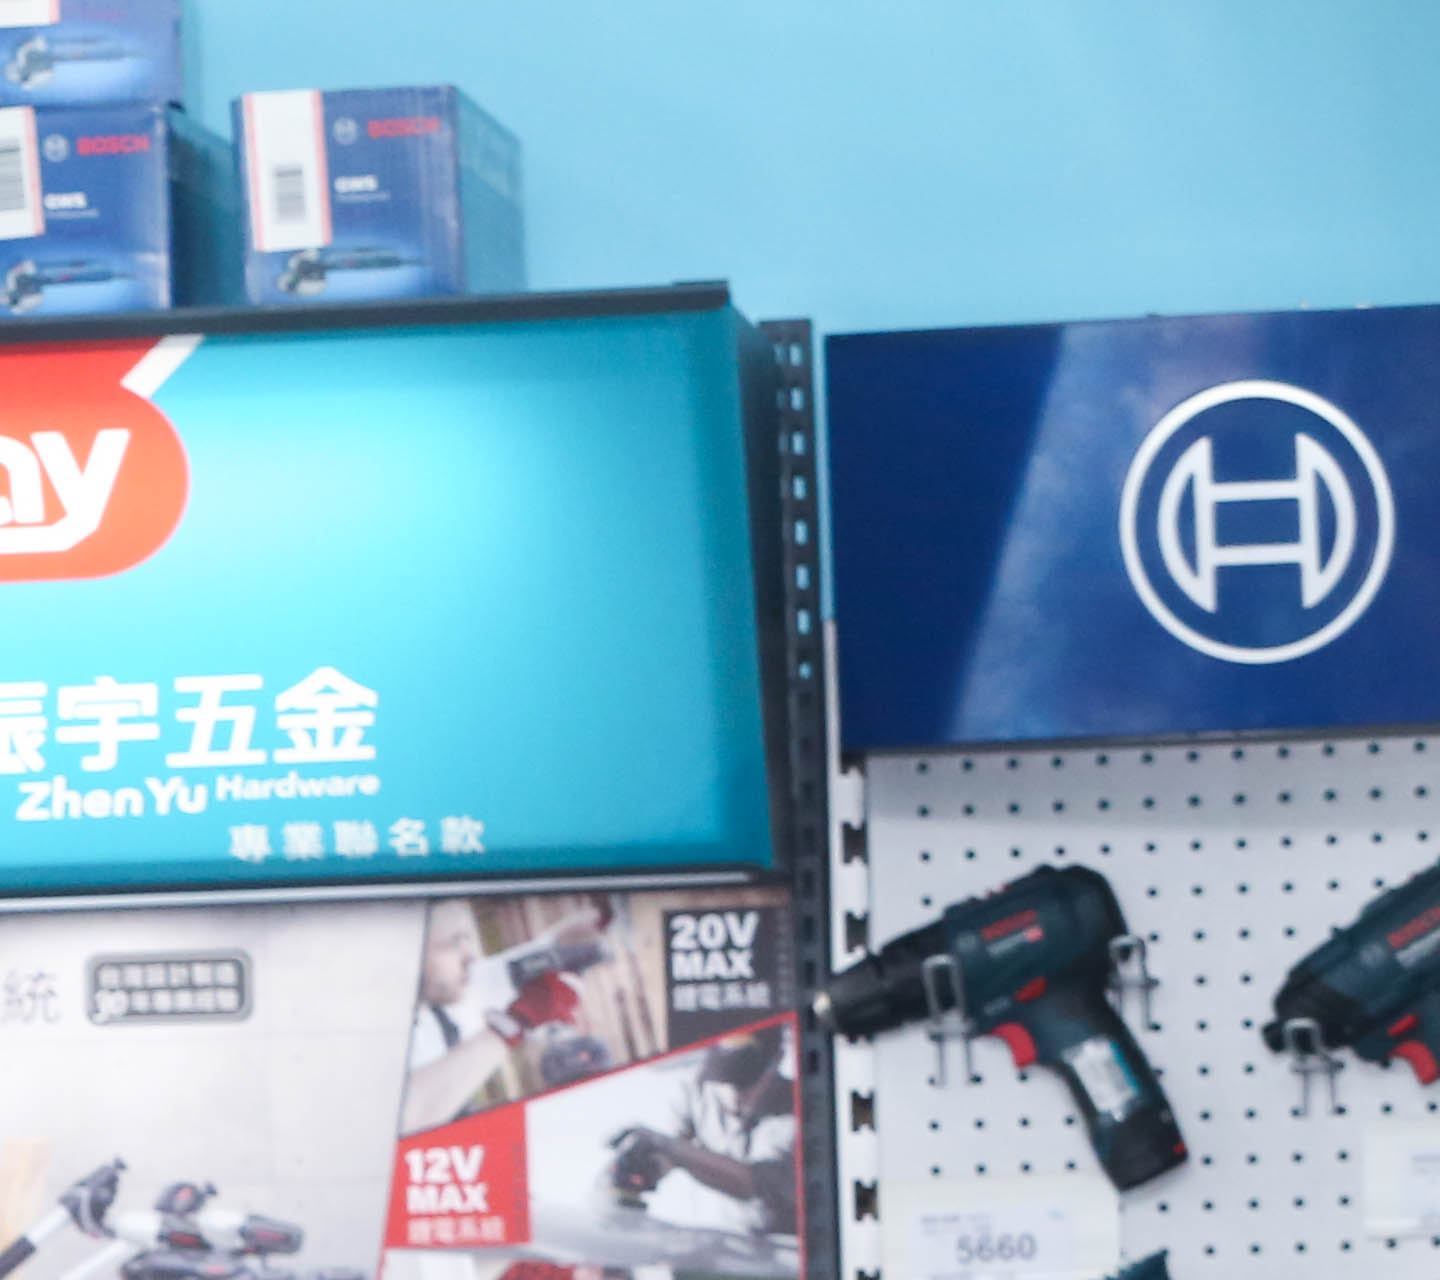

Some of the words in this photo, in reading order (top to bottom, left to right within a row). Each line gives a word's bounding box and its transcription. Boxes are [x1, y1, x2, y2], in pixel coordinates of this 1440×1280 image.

[367, 115, 442, 140] BOSCH
[77, 133, 150, 157] BOSCH
[215, 771, 381, 801] Hardware
[227, 814, 486, 863] 專業聯名款
[671, 911, 759, 949] 20V
[672, 949, 753, 979] MAX
[406, 1145, 484, 1183] 12V
[407, 1184, 486, 1214] MAX
[955, 1233, 1039, 1266] 5660
